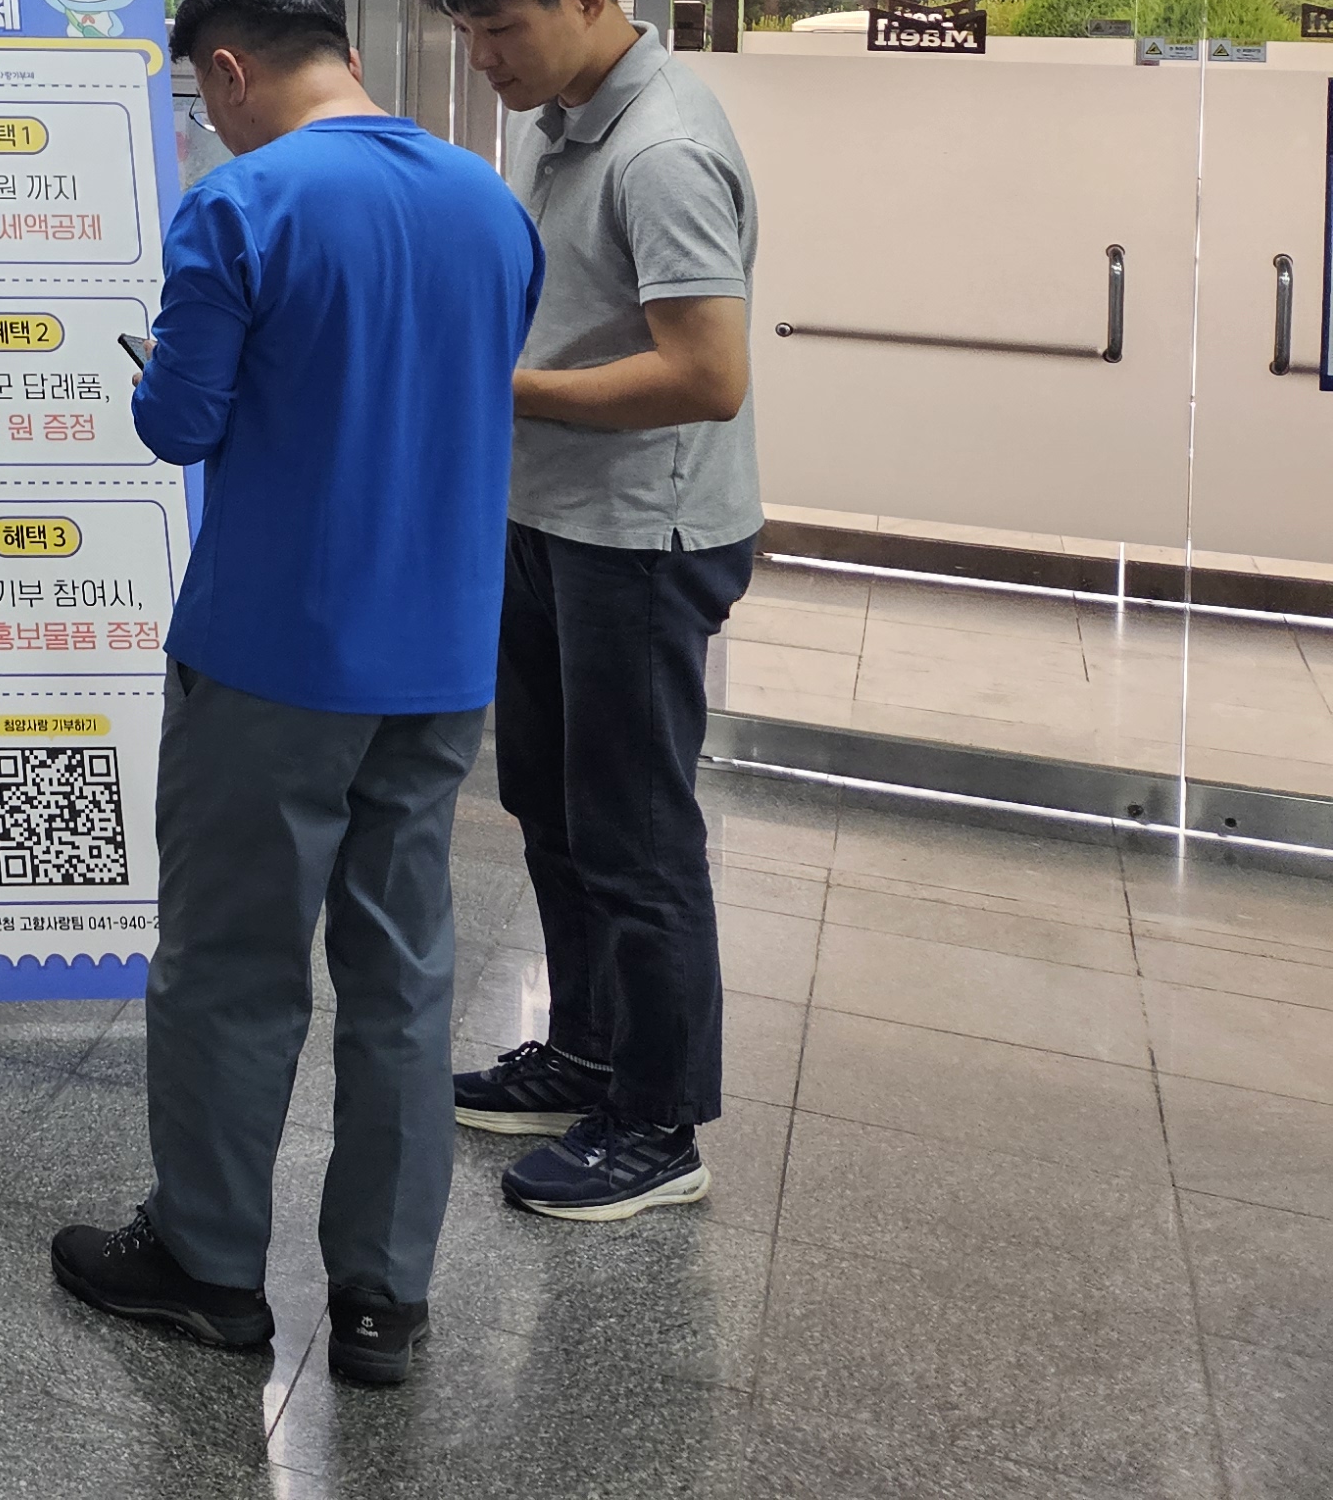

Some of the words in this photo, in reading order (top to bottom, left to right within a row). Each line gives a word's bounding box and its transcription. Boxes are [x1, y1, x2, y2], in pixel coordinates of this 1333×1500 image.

[22, 126, 31, 145] 1
[26, 174, 77, 200] 까지
[0, 214, 102, 240] 세액공제
[35, 322, 49, 342] 2
[23, 373, 110, 402] 답례품,
[8, 413, 33, 440] 원
[43, 413, 96, 441] 증정
[3, 525, 47, 549] 혜택
[53, 527, 66, 547] 3
[53, 579, 143, 610] 참여시,
[106, 621, 160, 650] 증정
[4, 719, 48, 732] 청양사랑
[52, 719, 97, 732] 기부하기
[20, 916, 83, 931] 고향사랑팀
